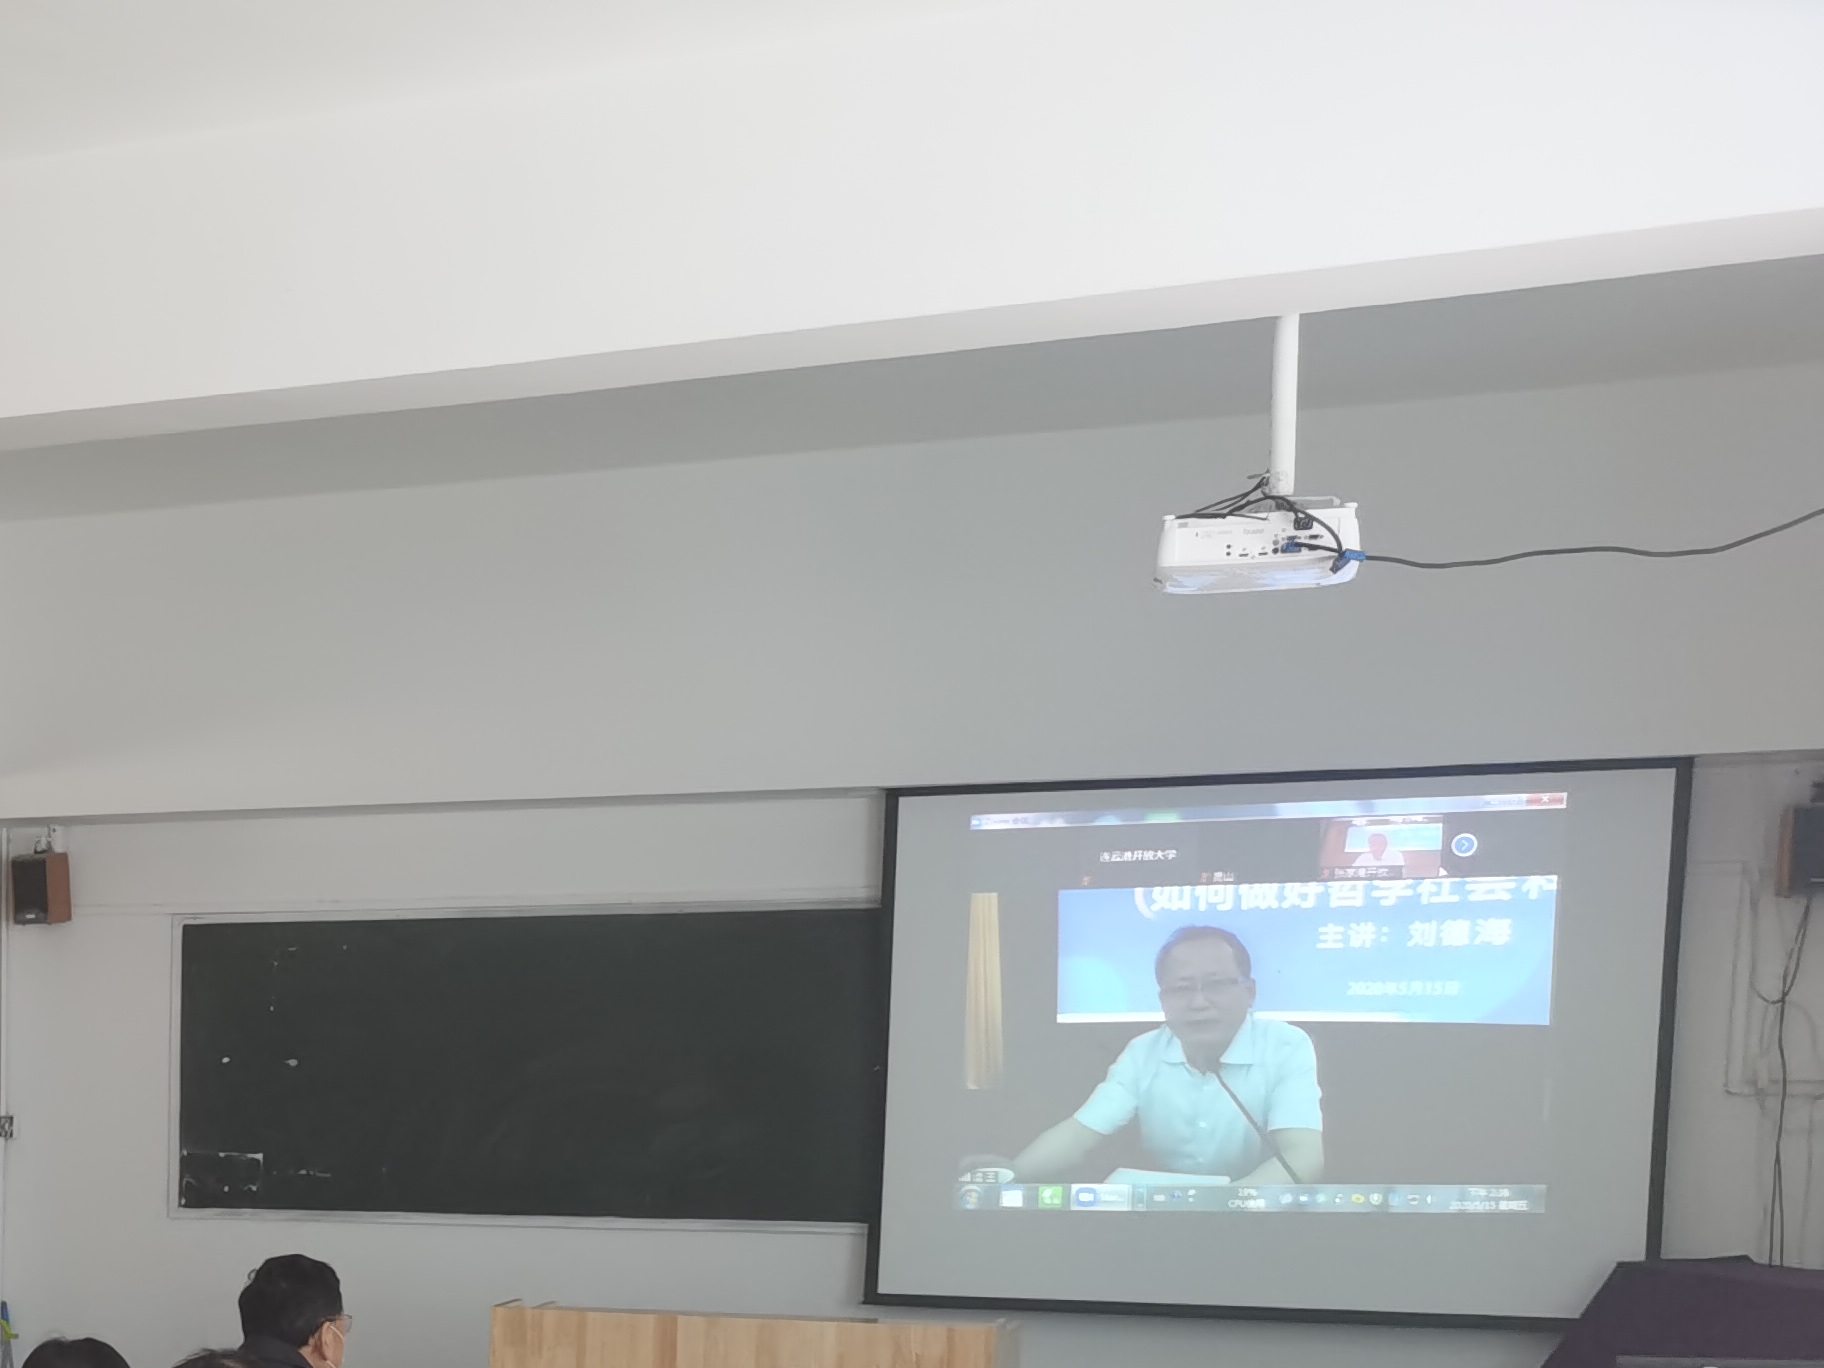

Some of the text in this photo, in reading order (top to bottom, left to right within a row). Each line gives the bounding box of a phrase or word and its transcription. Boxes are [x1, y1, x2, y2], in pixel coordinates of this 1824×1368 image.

[1100, 849, 1177, 862] 连云港开放大学
